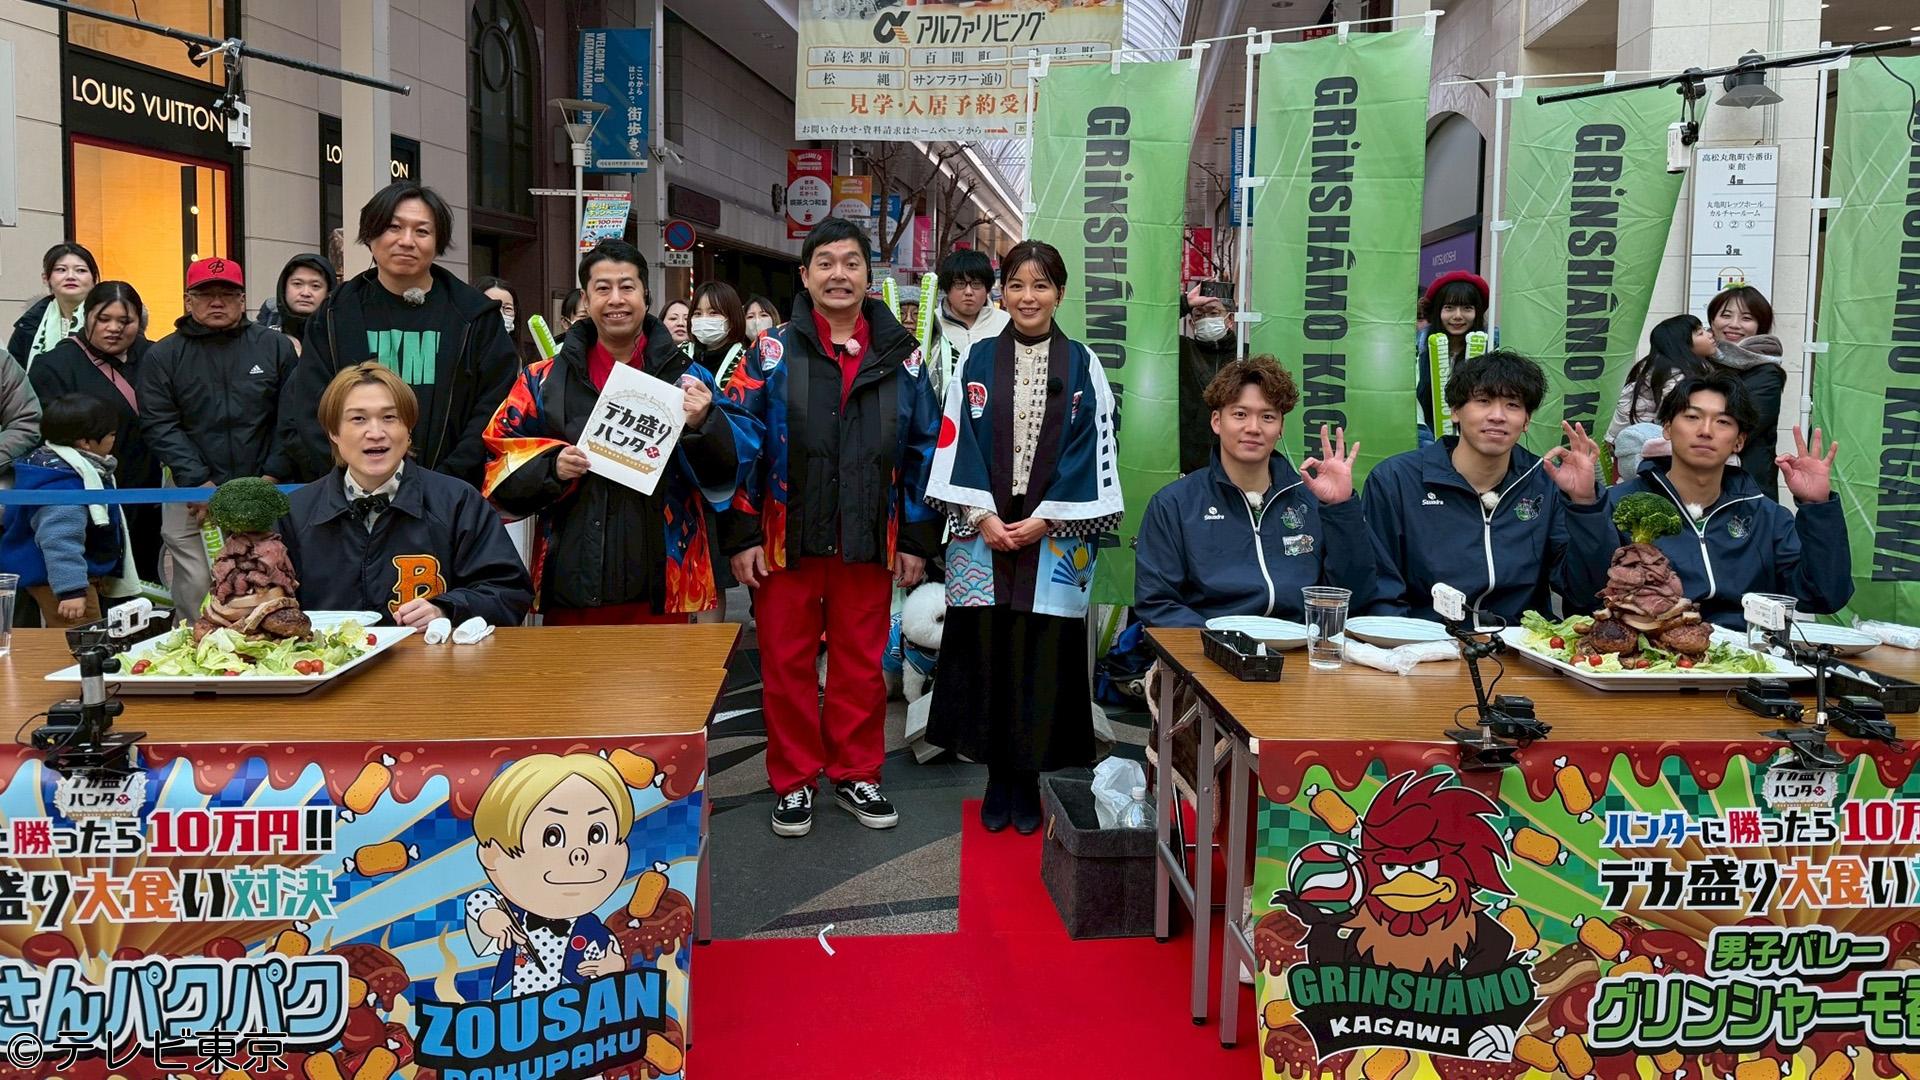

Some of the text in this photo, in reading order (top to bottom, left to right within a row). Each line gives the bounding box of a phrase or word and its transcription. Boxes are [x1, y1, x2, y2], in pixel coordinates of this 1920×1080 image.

[916, 11, 1046, 44] アルファリビング
[594, 33, 606, 83] WELCOME TO
[823, 50, 890, 64] 高松駅前
[913, 72, 1002, 86] サンフラワー通り
[72, 75, 224, 134] LOUIS VUITTON
[605, 402, 672, 445] デカ盛り
[388, 554, 447, 616] B
[1601, 857, 1920, 912] デカ盛り大食い
[1713, 931, 1884, 971] 男子バレー
[419, 970, 661, 1059] ZOUSAN
[1329, 1014, 1460, 1046] KAGAWA
